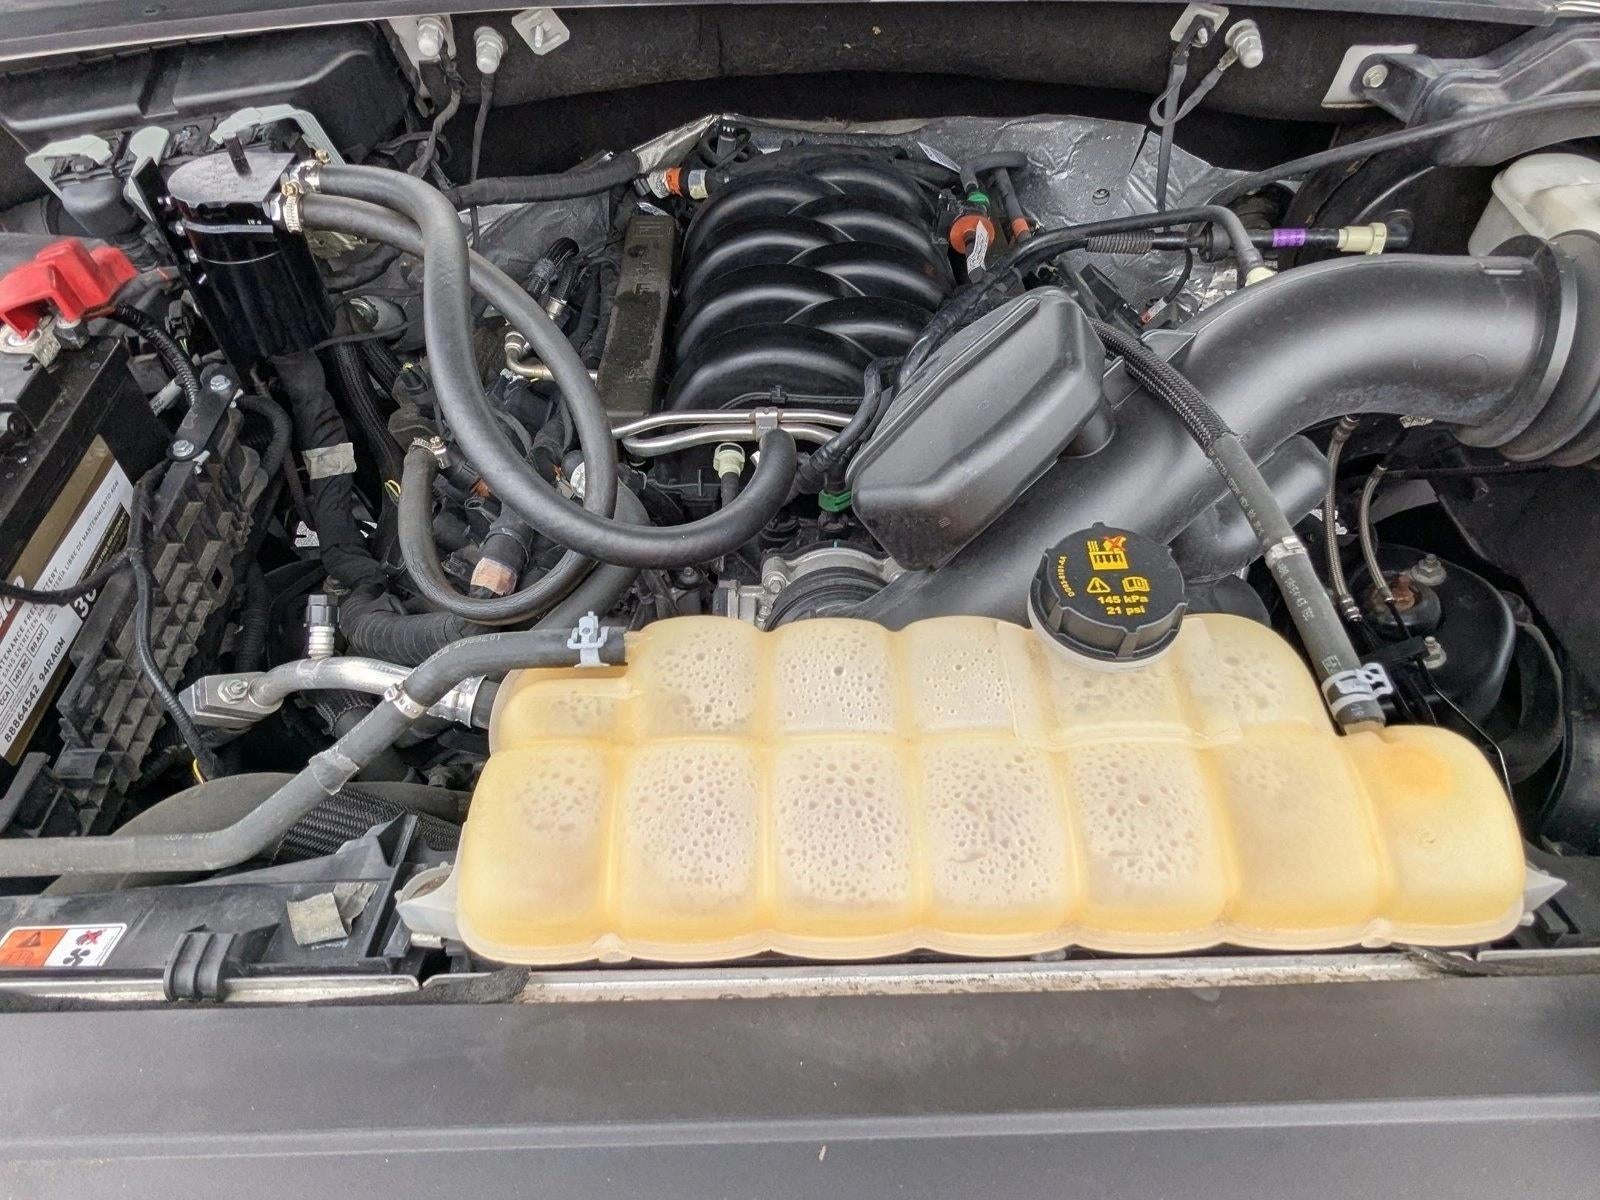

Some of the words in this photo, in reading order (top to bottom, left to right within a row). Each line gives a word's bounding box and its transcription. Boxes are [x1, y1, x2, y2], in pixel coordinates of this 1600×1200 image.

[1097, 595, 1121, 604] 145
[1123, 595, 1149, 603] kPa
[1106, 606, 1122, 615] 21
[1126, 605, 1145, 616] psi
[21, 659, 29, 670] RC
[4, 684, 40, 743] 88864542
[39, 637, 66, 682] 94RAGM
